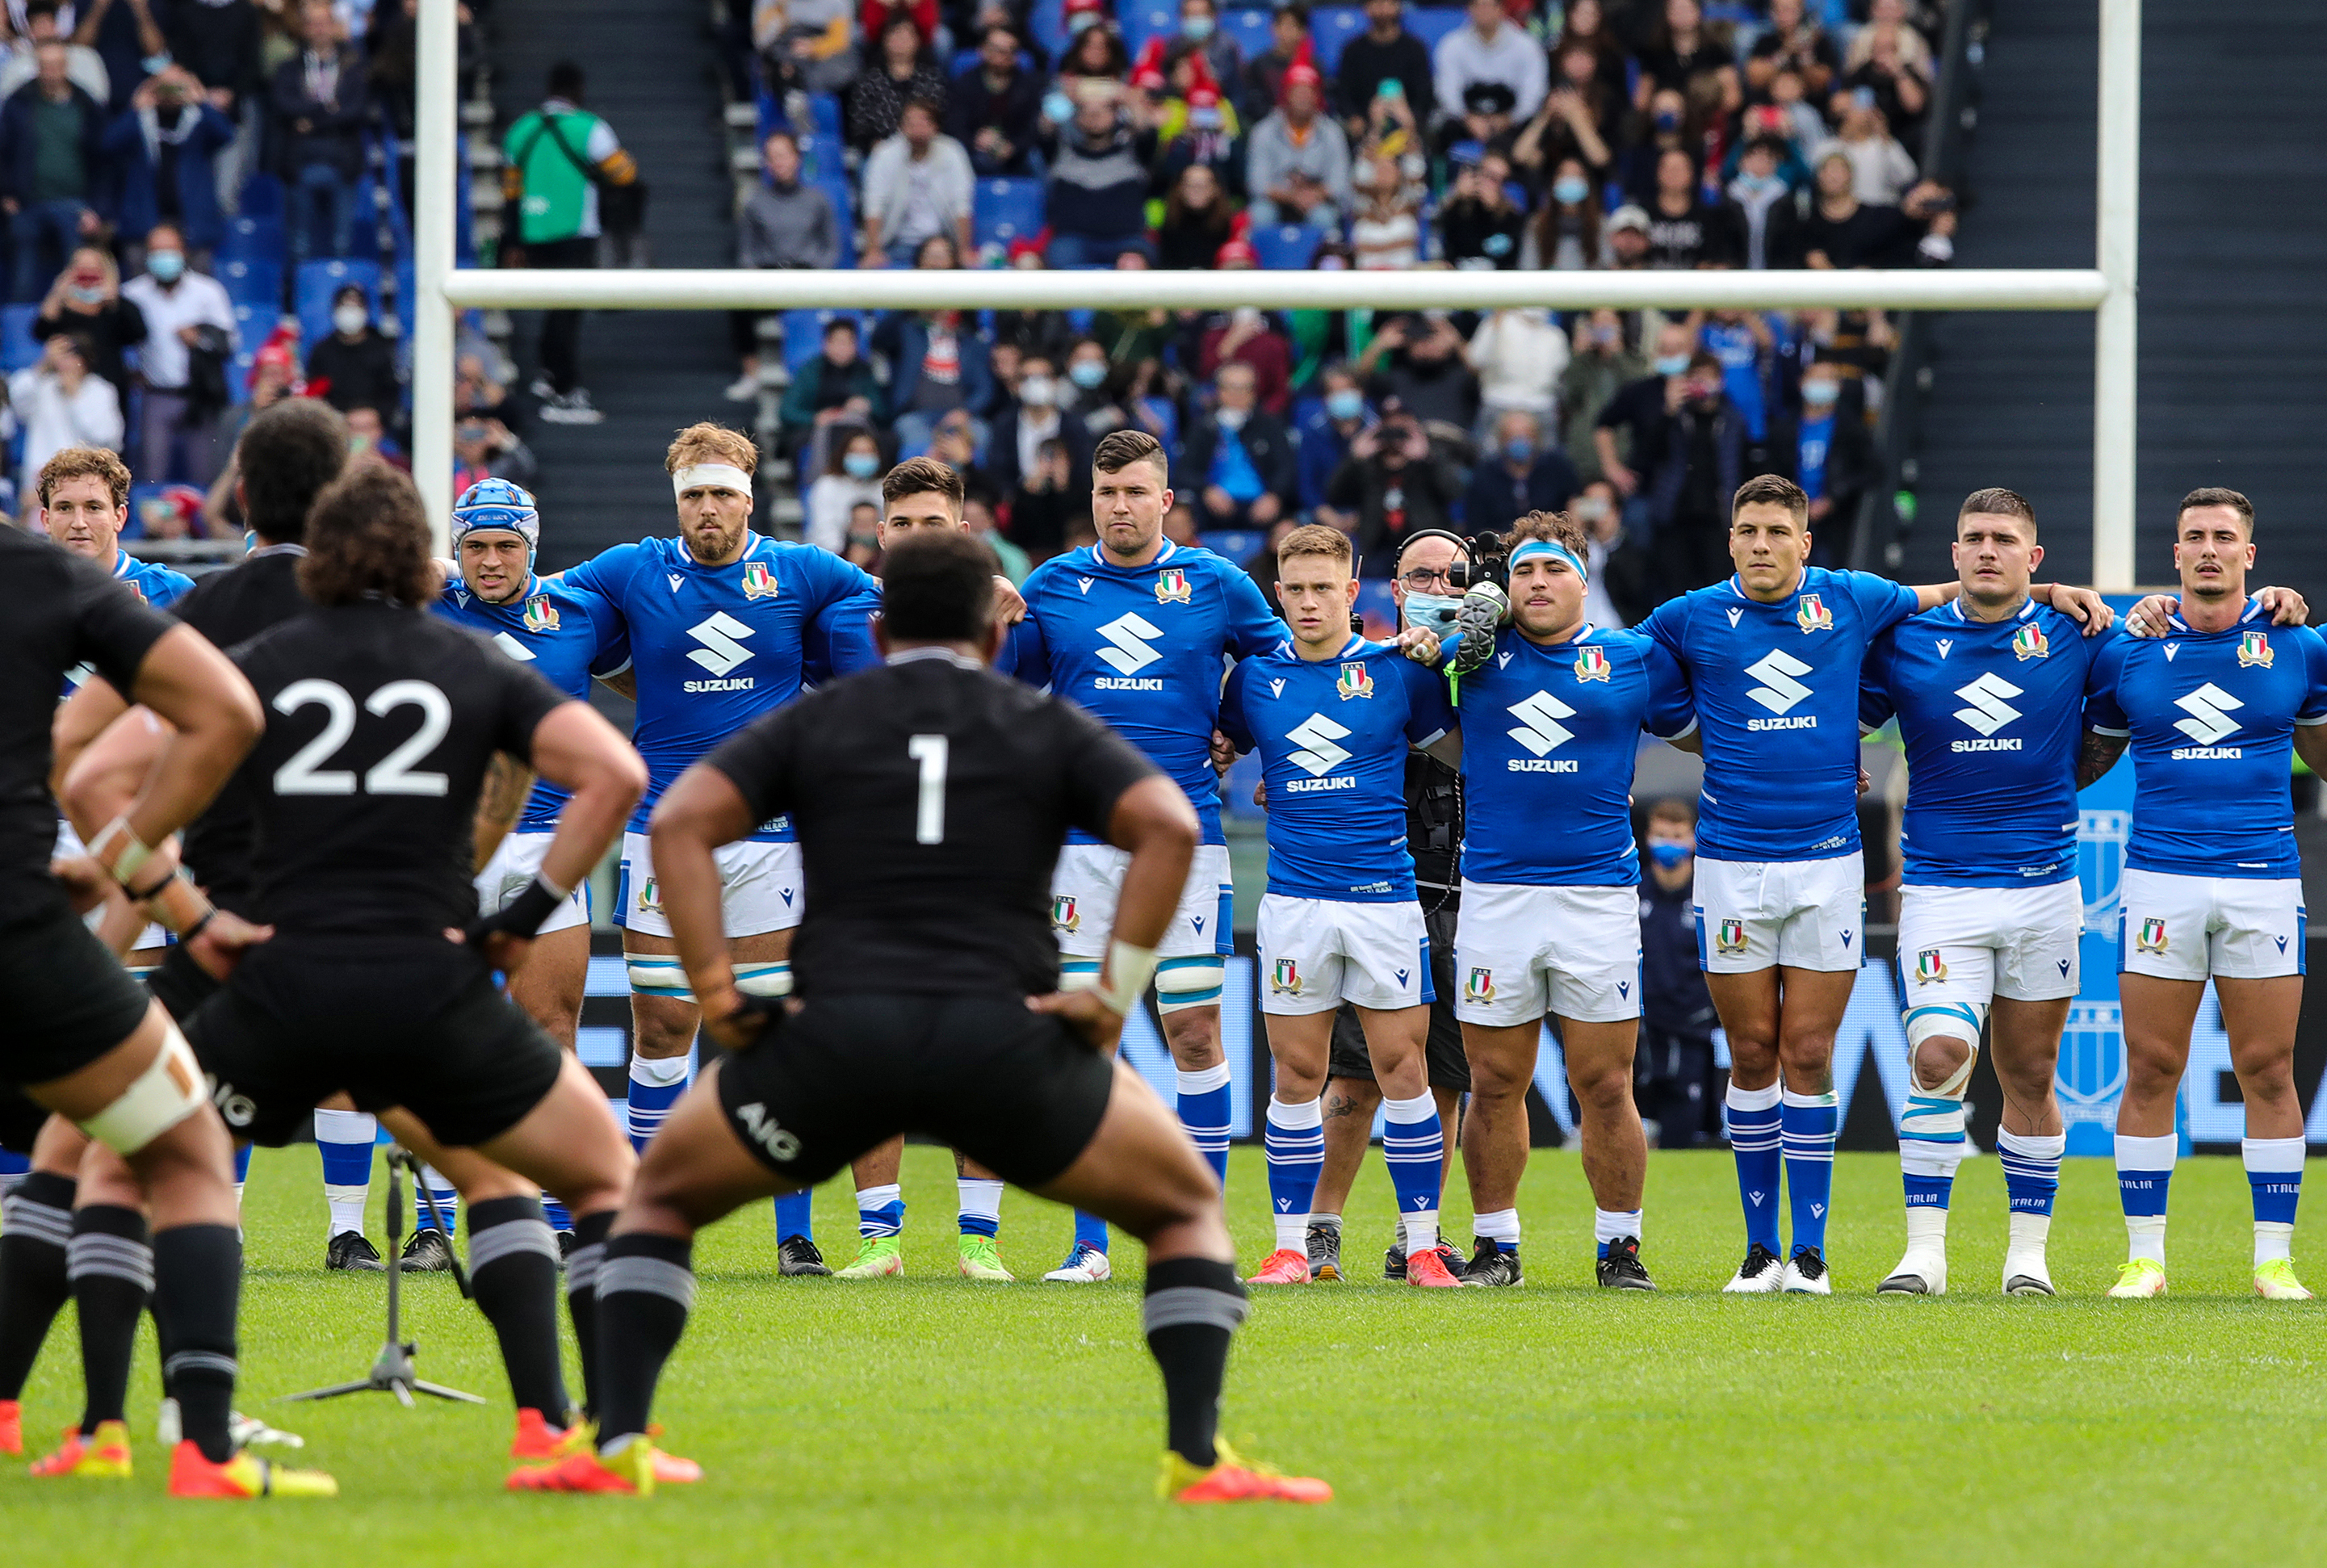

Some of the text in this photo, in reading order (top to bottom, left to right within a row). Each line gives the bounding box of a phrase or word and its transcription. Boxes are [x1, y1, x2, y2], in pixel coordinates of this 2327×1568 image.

[684, 677, 754, 693] SUZUKI
[1094, 678, 1163, 691] SUZUKI
[1747, 716, 1818, 731] SUZUKI
[272, 678, 452, 795] 22
[1951, 738, 2022, 753] SUZUKI
[2172, 748, 2242, 760] SUZUKI
[1508, 760, 1579, 774] SUZUKI
[908, 734, 948, 845] 1
[1286, 777, 1356, 793] SUZUKI
[736, 1102, 802, 1162] AIG
[1906, 1193, 1938, 1204] ITALIA
[2011, 1198, 2046, 1208] ITALIA
